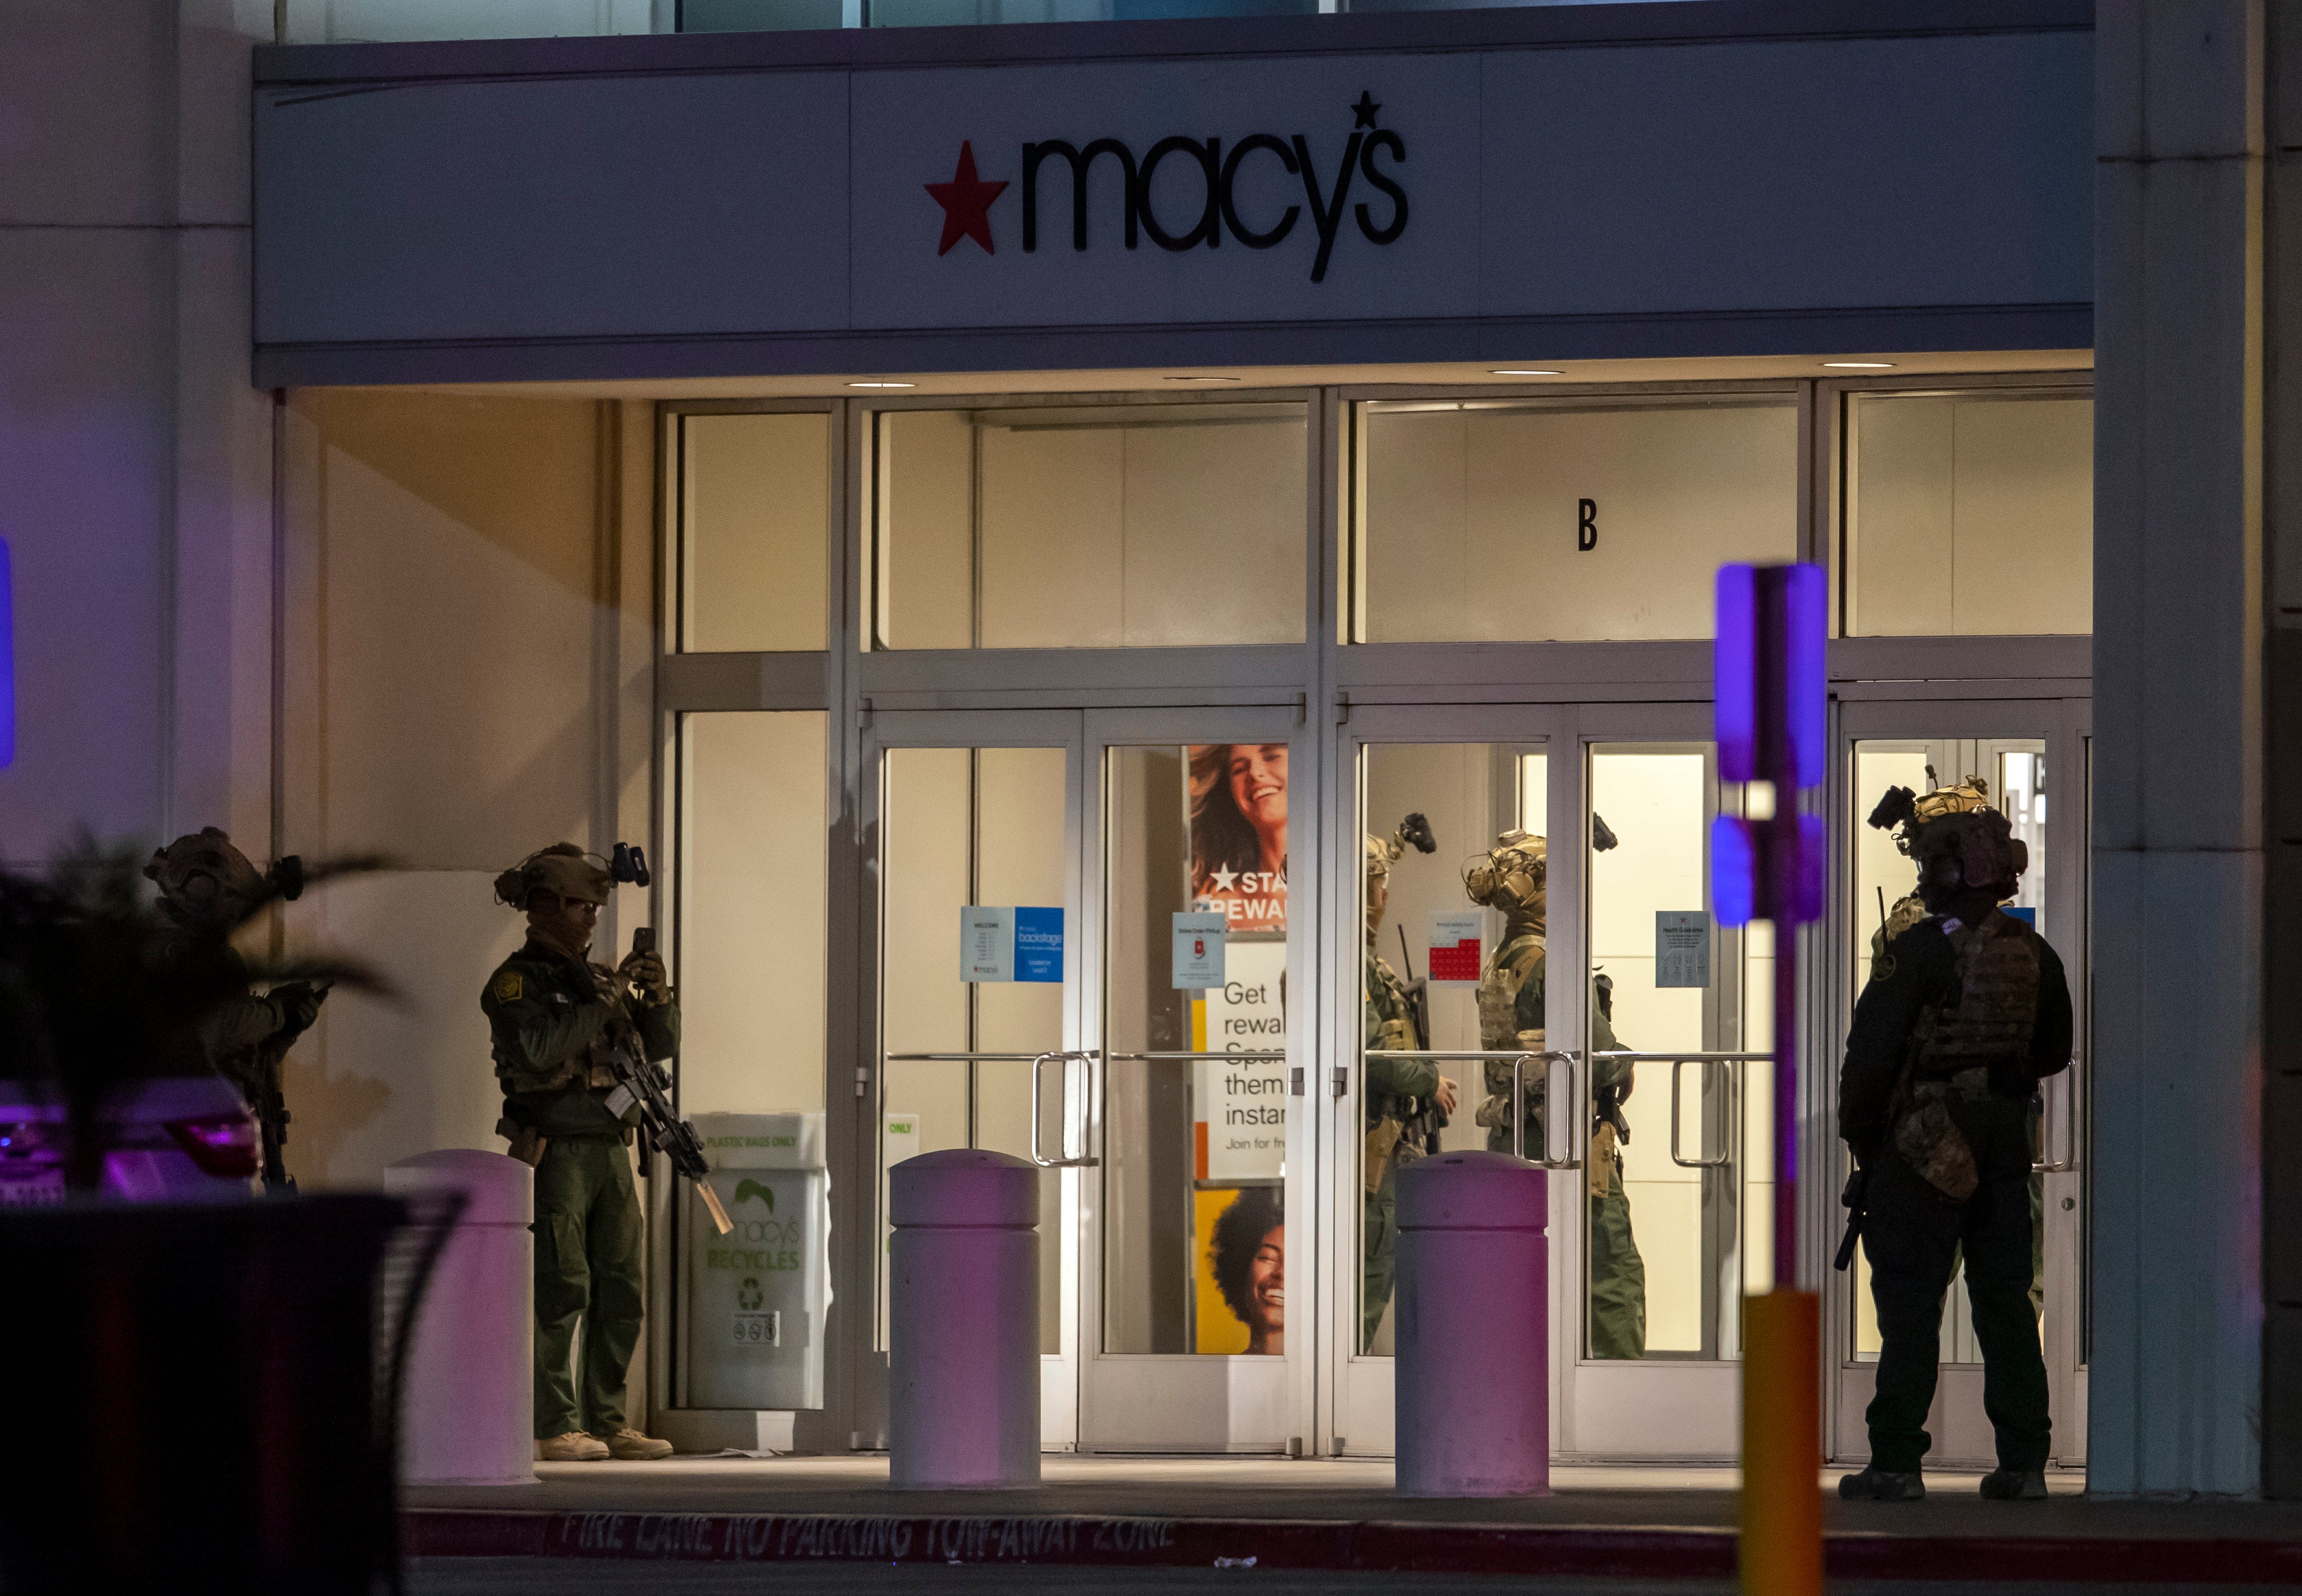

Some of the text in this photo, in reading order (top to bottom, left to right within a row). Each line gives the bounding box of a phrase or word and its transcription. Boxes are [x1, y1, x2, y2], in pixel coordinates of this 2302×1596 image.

[1022, 91, 1409, 283] macy's
[1578, 499, 1597, 551] B
[1224, 981, 1267, 1005] Get
[1225, 1073, 1284, 1095] them
[889, 1123, 911, 1133] ONLY
[707, 1136, 796, 1147] PLASTIC BAGS ONLY
[1226, 1137, 1251, 1150] Join
[1254, 1137, 1270, 1149] for
[708, 1249, 799, 1270] RECYCLES
[561, 1514, 624, 1550] FIRE
[635, 1515, 713, 1553] LANE
[724, 1517, 773, 1557] NO
[778, 1518, 913, 1559] PARKING
[1091, 1521, 1178, 1552] ZONE
